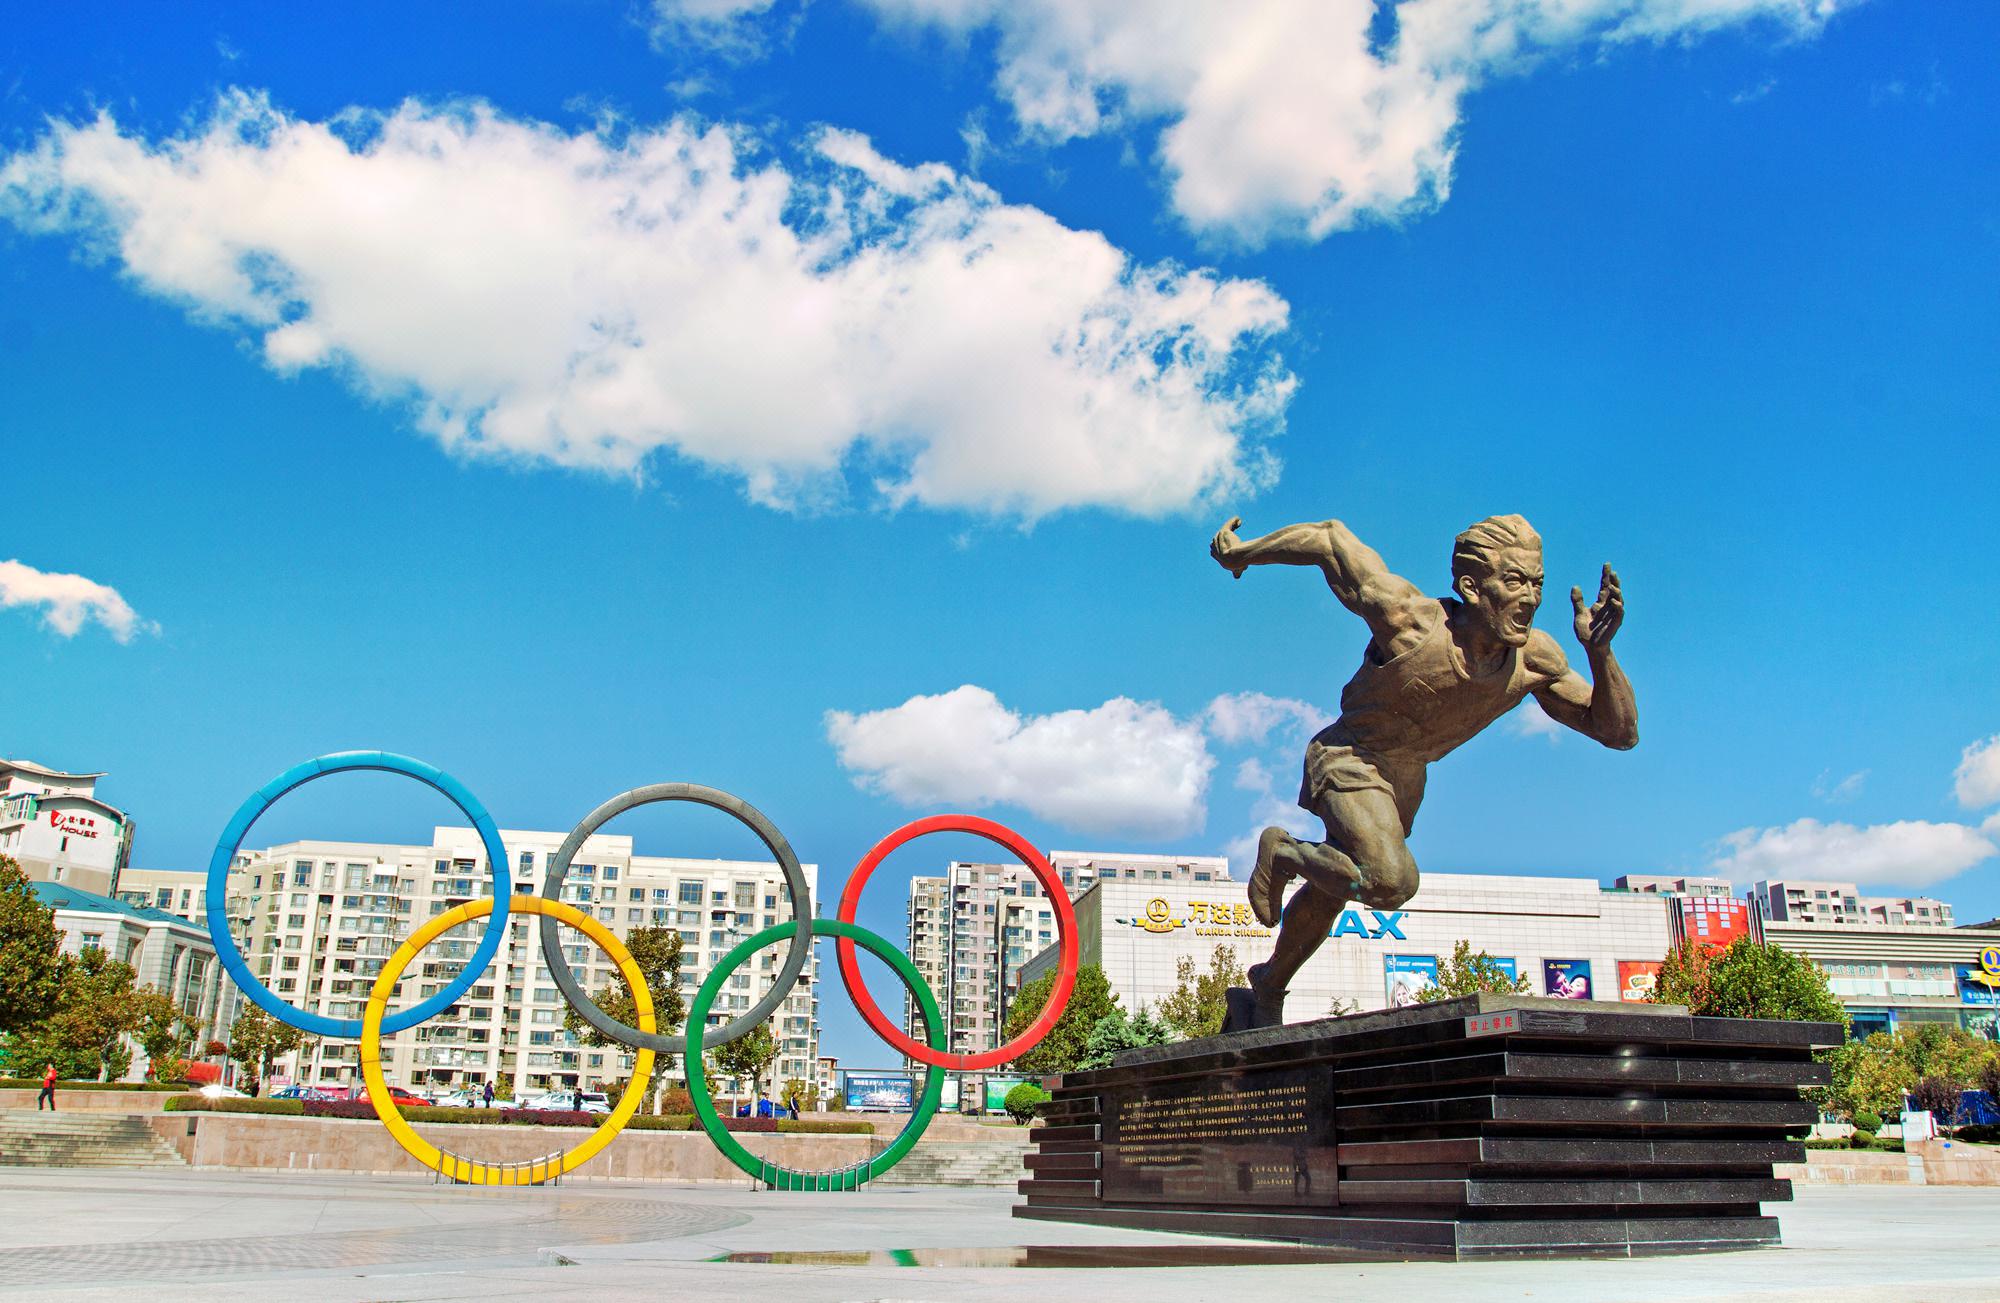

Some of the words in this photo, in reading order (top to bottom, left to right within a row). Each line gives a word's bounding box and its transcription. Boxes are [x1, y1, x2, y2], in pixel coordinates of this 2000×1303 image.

[60, 824, 98, 839] HOUSE
[1187, 901, 1260, 926] 万达影
[1195, 927, 1232, 937] WANDA
[1234, 929, 1272, 938] CINEMA
